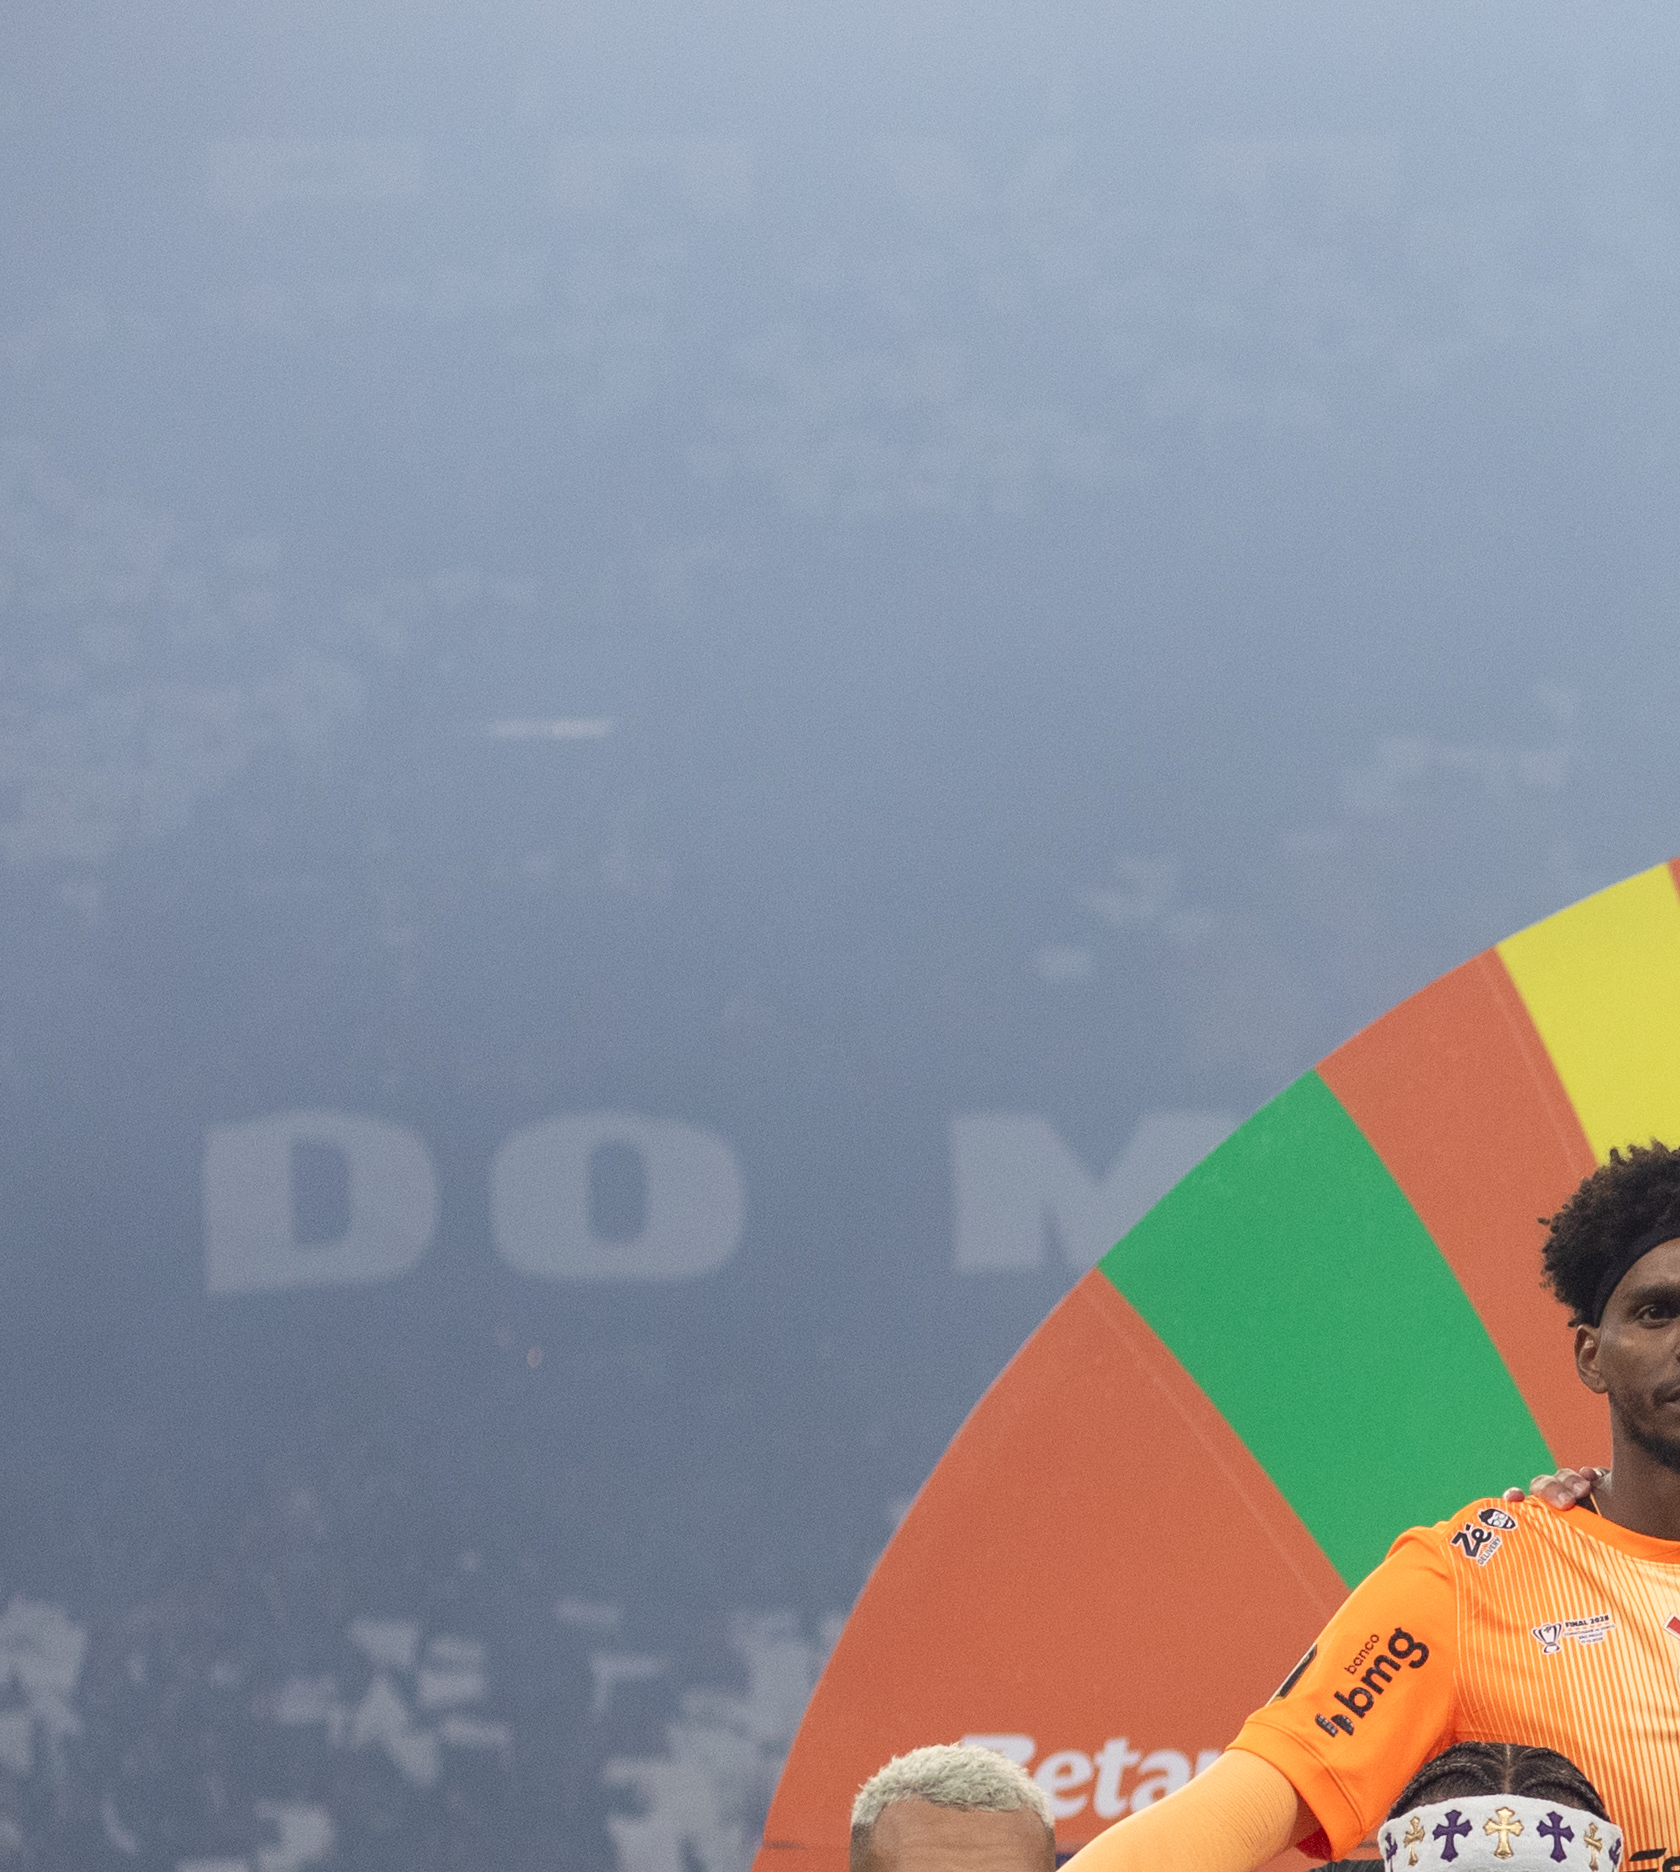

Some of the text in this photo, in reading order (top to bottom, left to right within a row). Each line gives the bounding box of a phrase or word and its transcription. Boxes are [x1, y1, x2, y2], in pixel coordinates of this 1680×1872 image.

[206, 1107, 747, 1295] DO
[1451, 1523, 1493, 1559] Zé
[1333, 1626, 1430, 1719] bmg
[1343, 1633, 1380, 1676] banco
